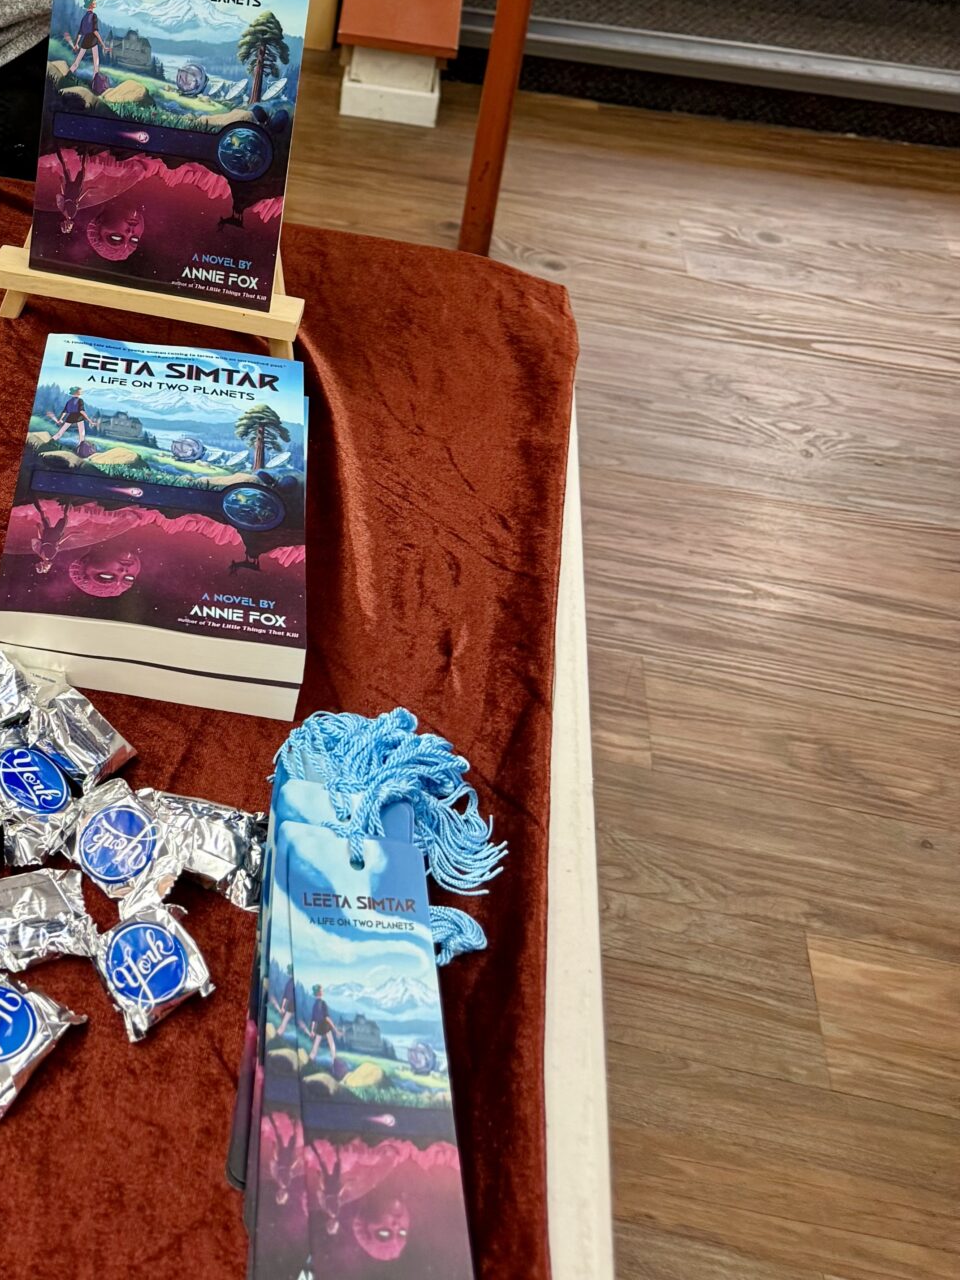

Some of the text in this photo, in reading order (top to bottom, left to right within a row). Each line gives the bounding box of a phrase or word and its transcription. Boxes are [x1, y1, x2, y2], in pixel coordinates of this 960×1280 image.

[191, 252, 253, 271] A NOVEL BY
[181, 266, 260, 290] ANNIE FOX
[206, 284, 221, 293] Little
[222, 287, 242, 297] Things
[242, 291, 256, 299] That
[257, 293, 268, 301] Kill
[63, 351, 280, 393] LEETA SIMTAR
[87, 375, 256, 402] A LIFE ON TWO PLANETS
[201, 592, 276, 609] A NOVEL BY
[189, 604, 287, 628] ANNIE FOX
[207, 620, 221, 628] The
[222, 622, 241, 630] Little
[243, 625, 267, 634] Things
[268, 628, 285, 636] That
[84, 816, 162, 870] York
[303, 892, 416, 914] LEETA SIMTAR
[317, 917, 336, 926] LIFE
[336, 918, 351, 927] ON
[353, 919, 374, 928] TWO
[376, 921, 415, 931] PLANETS
[111, 928, 179, 1012] York
